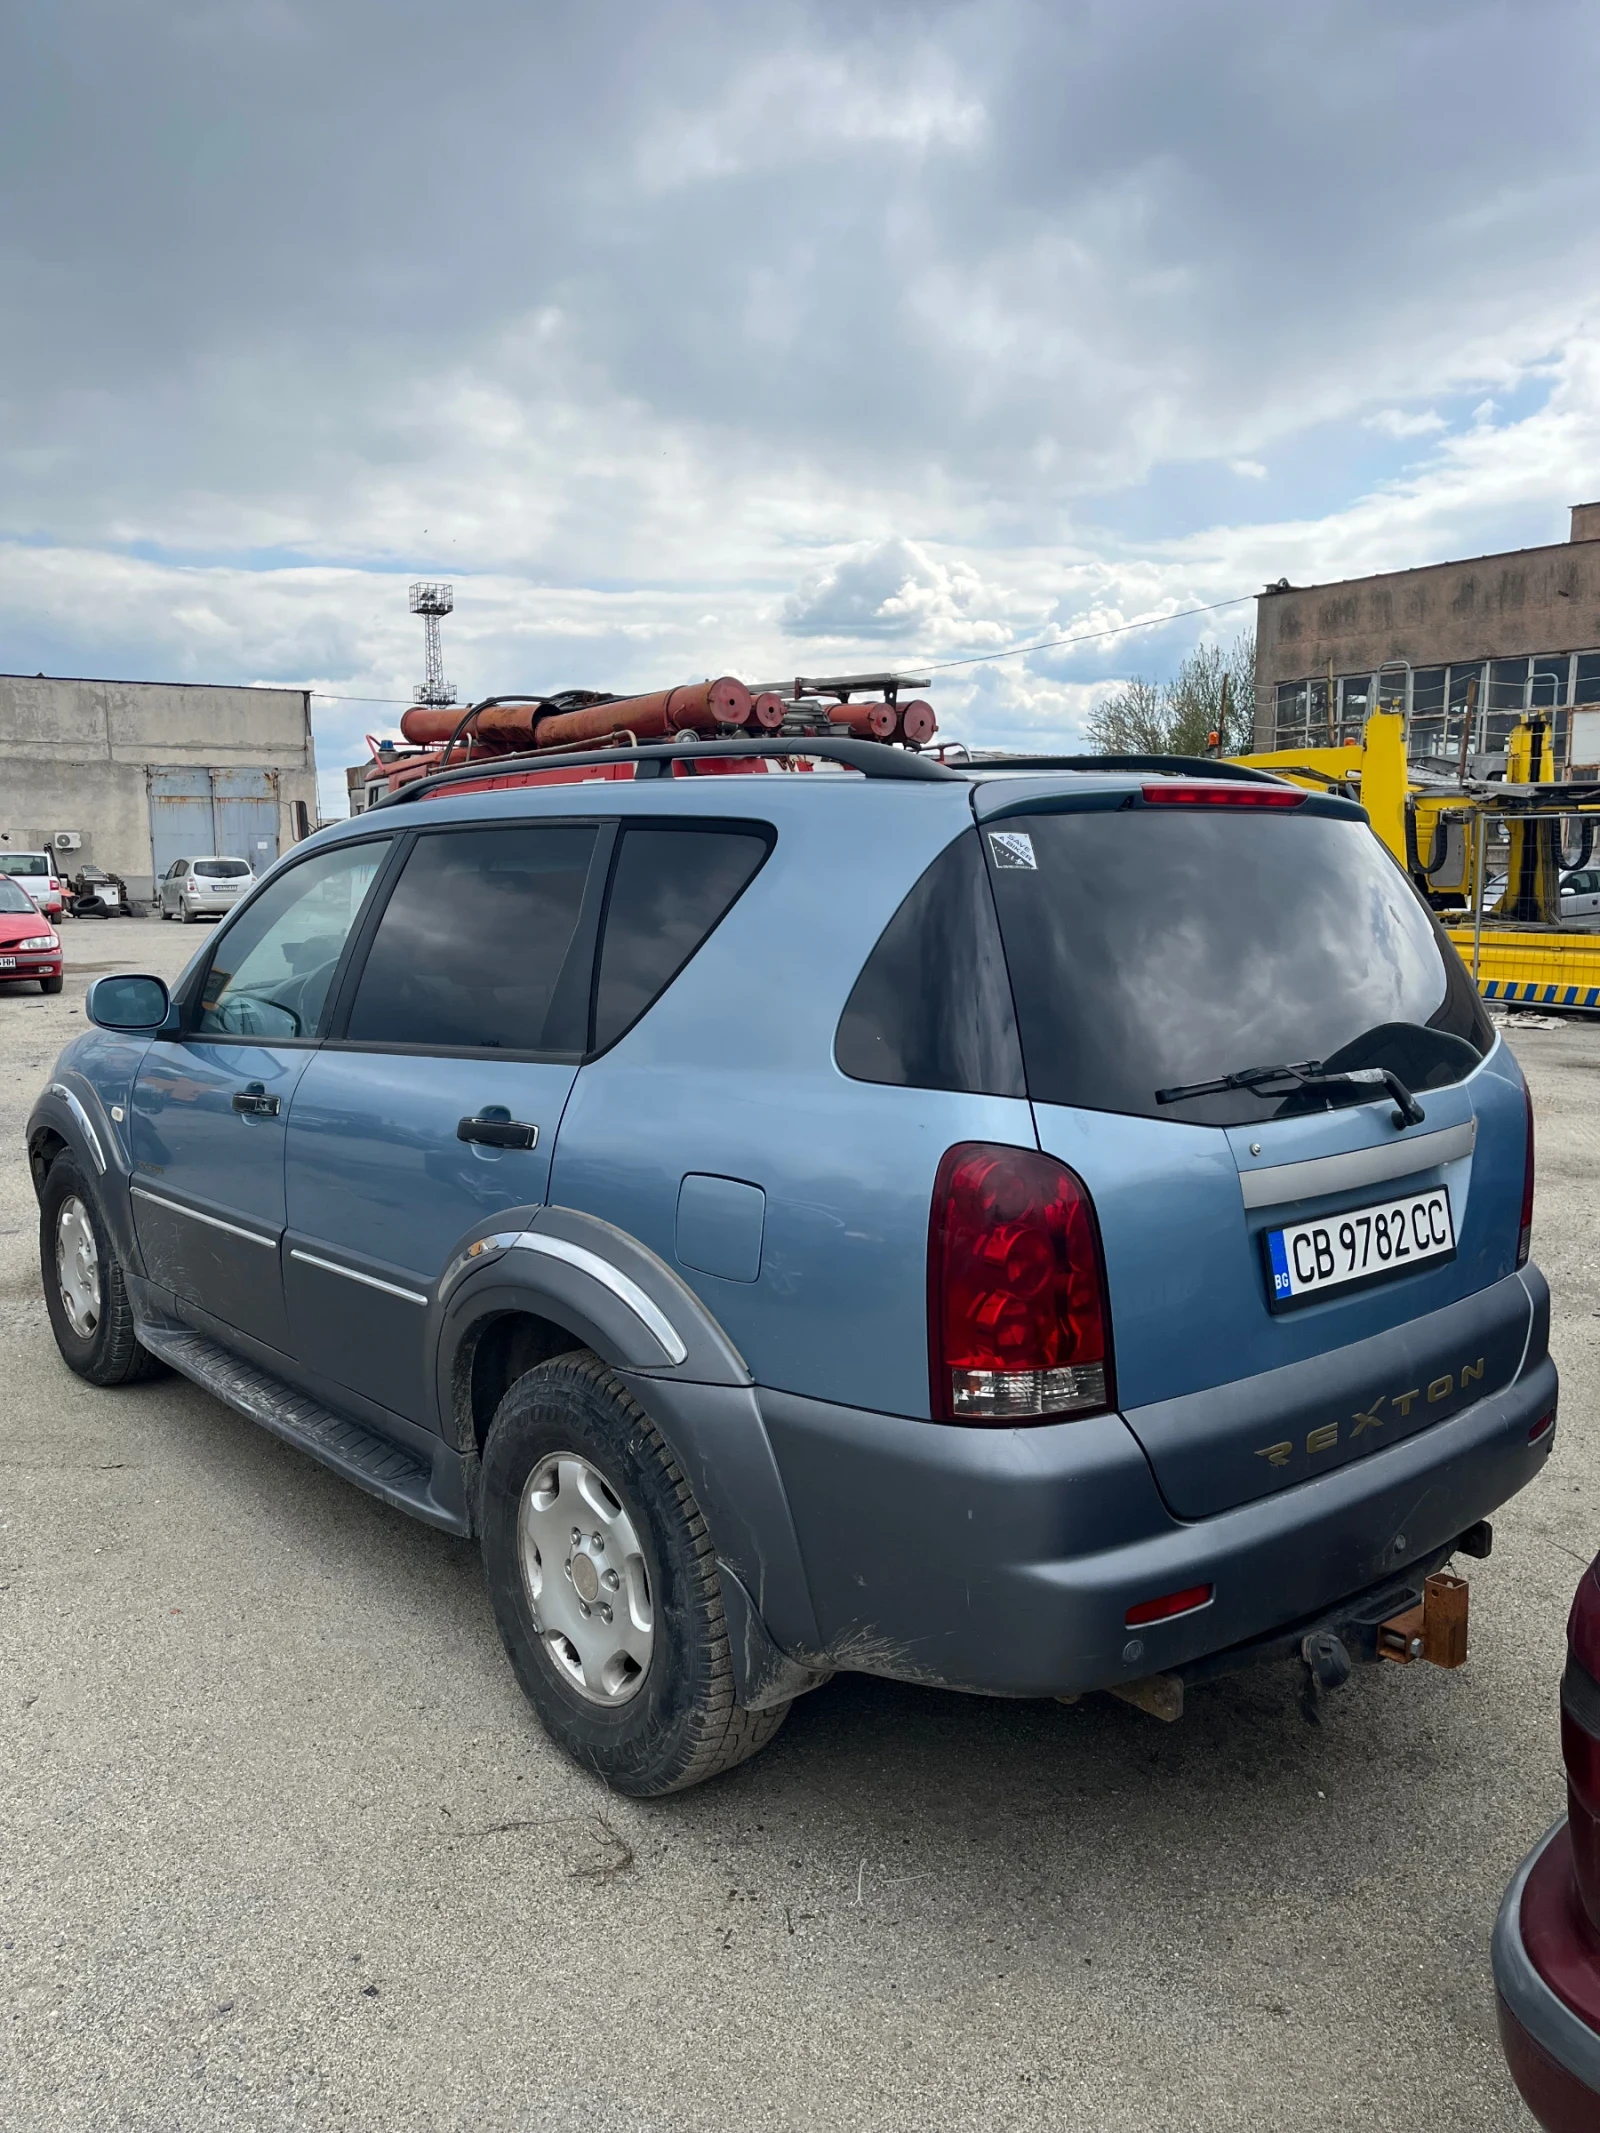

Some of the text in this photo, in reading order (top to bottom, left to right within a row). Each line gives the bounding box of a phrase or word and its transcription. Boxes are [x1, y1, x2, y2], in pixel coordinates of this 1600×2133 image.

[1006, 841, 1032, 861] BIKER
[1007, 834, 1031, 853] SAVE
[1292, 1199, 1447, 1284] CB 9782 CC
[1273, 1273, 1289, 1290] BG
[1254, 1357, 1484, 1467] REXTON
